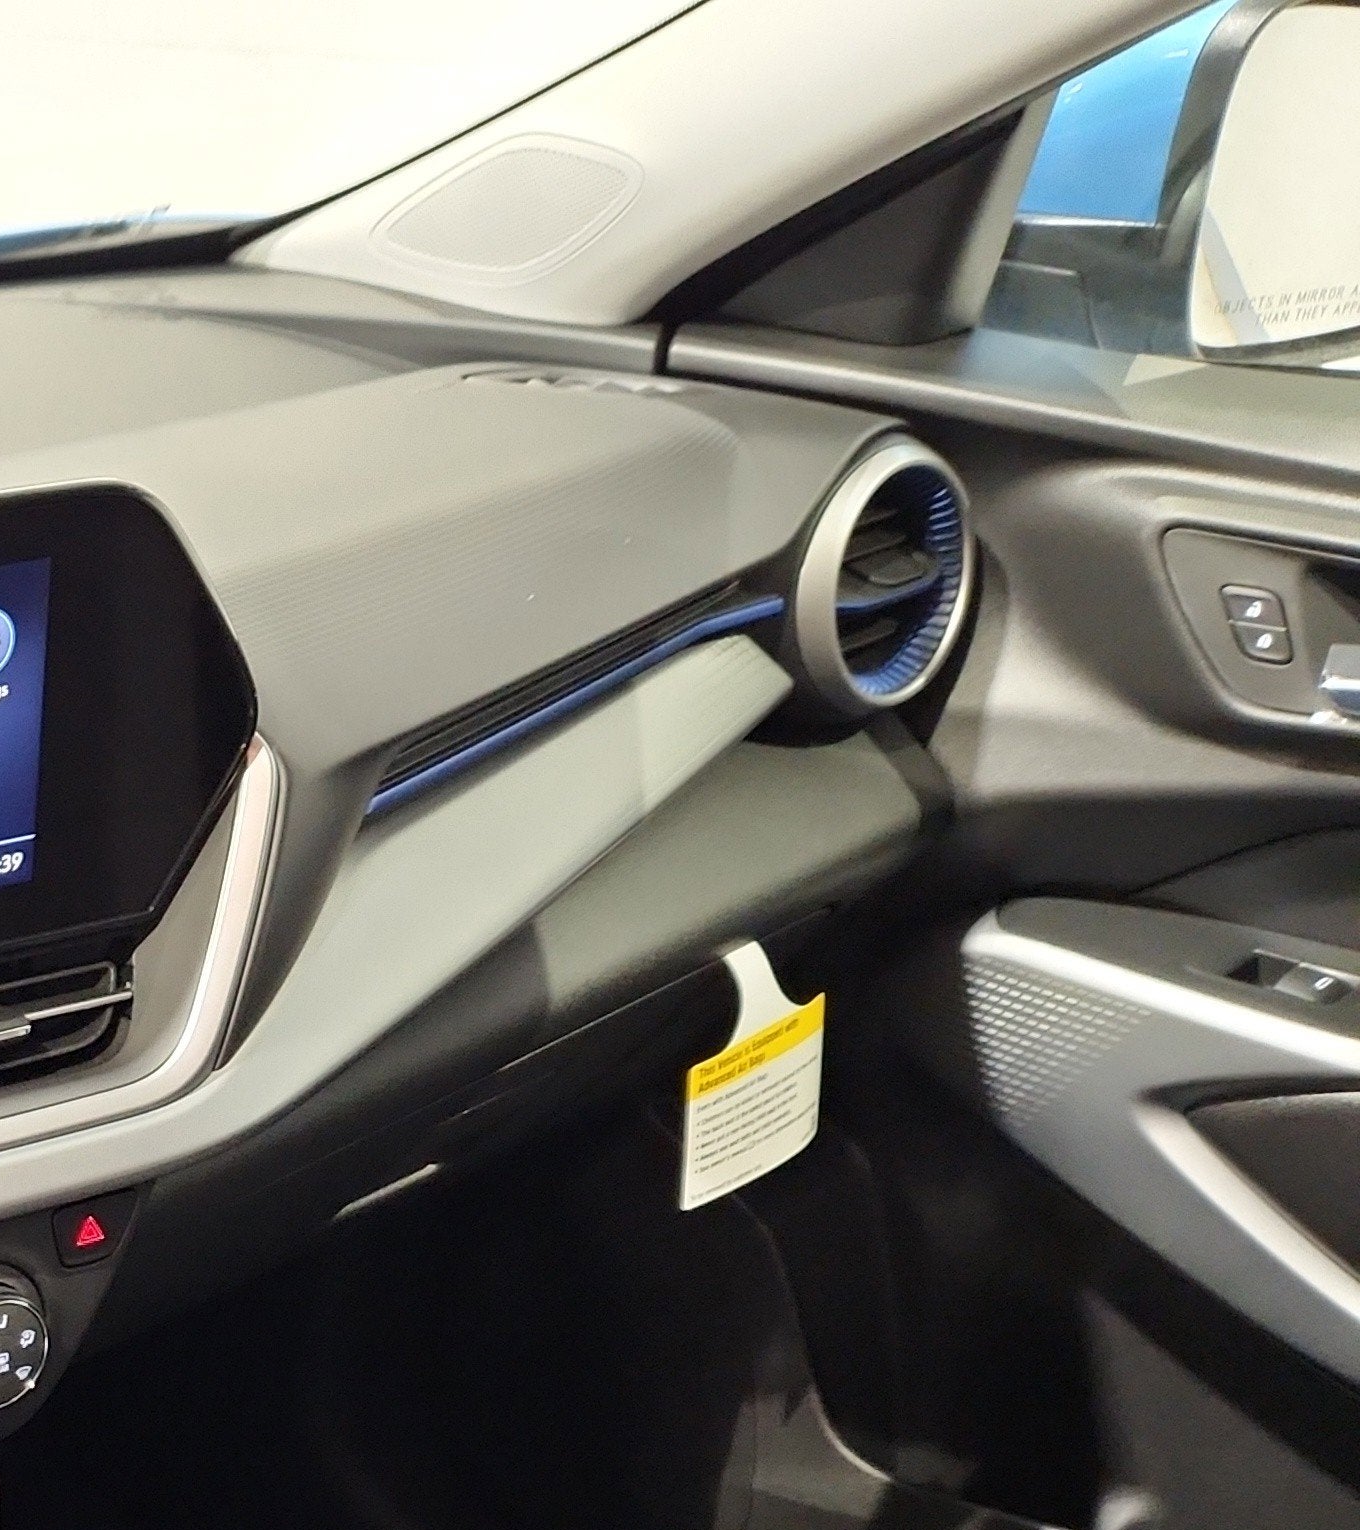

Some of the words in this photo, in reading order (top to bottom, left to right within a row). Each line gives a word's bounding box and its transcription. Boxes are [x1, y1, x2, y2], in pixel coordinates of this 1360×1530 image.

[1295, 284, 1346, 305] MIRROR
[1254, 309, 1291, 328] THAN
[1294, 303, 1329, 322] THEY
